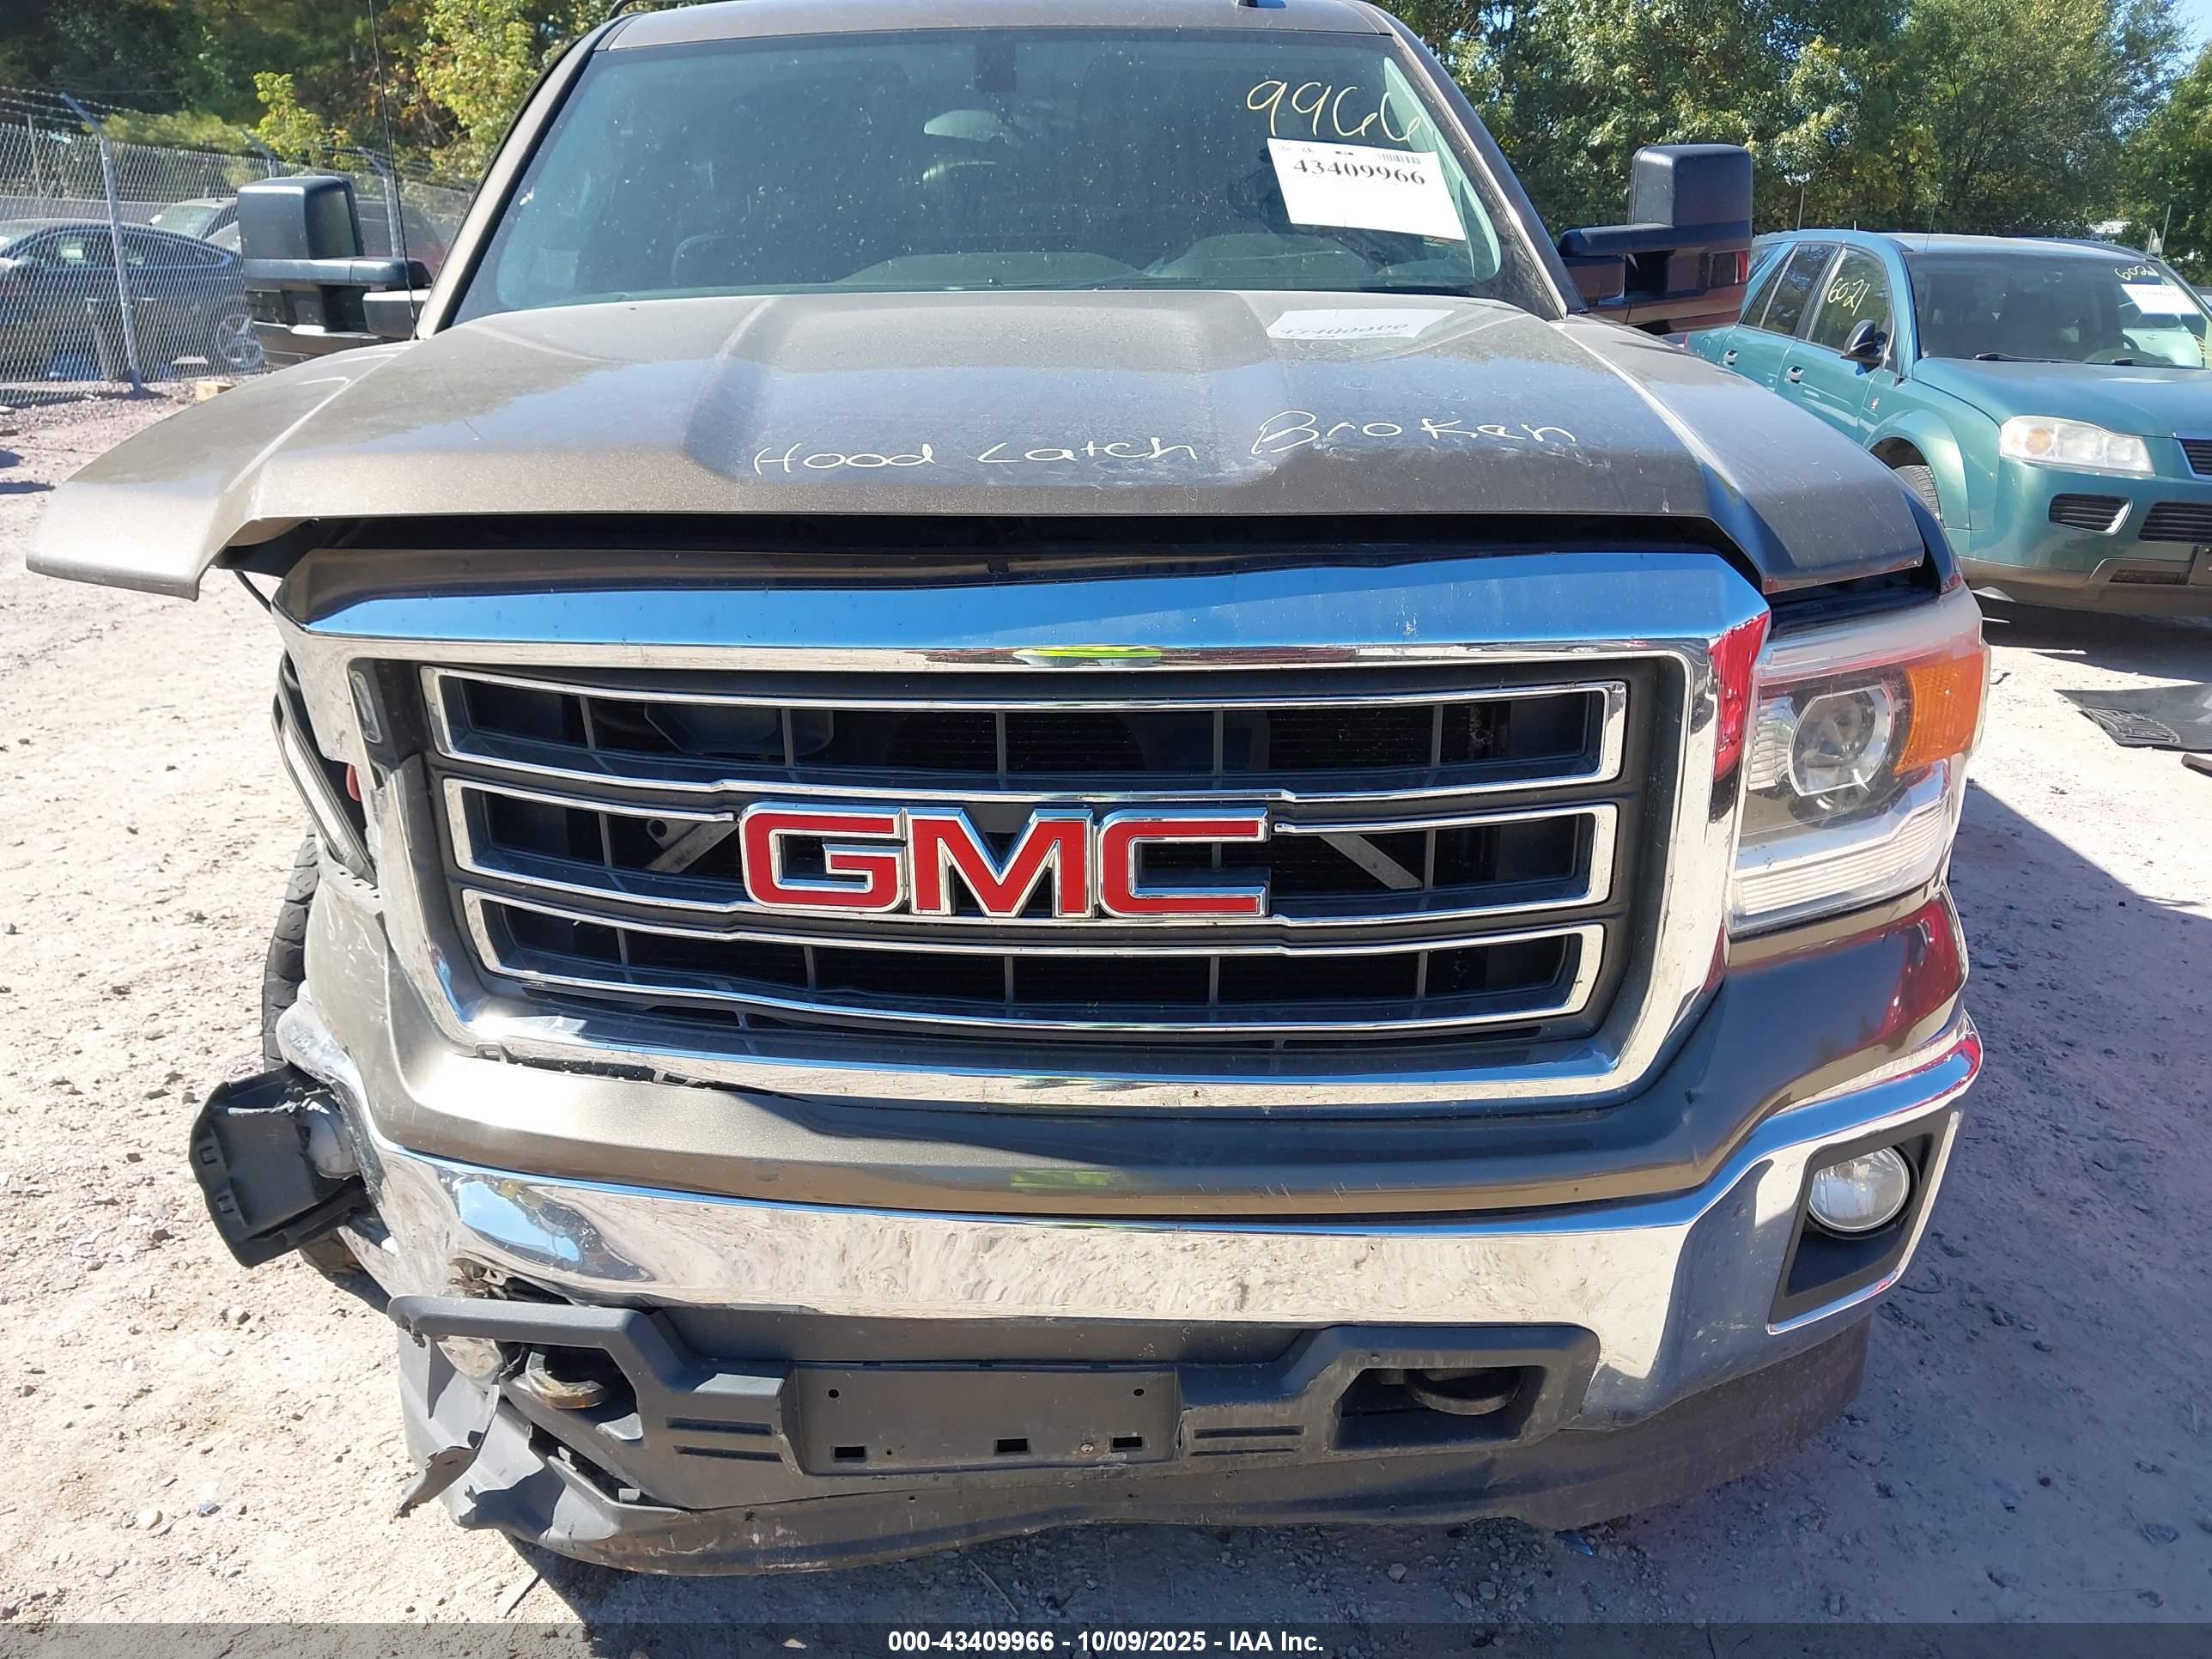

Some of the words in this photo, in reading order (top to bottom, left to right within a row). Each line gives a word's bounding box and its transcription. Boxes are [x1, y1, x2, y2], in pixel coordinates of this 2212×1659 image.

[1293, 159, 1425, 185] 43409966
[1827, 276, 1871, 316] 6021
[752, 442, 936, 475] Hood
[976, 436, 1198, 464] Latch
[739, 800, 1271, 918] GMC
